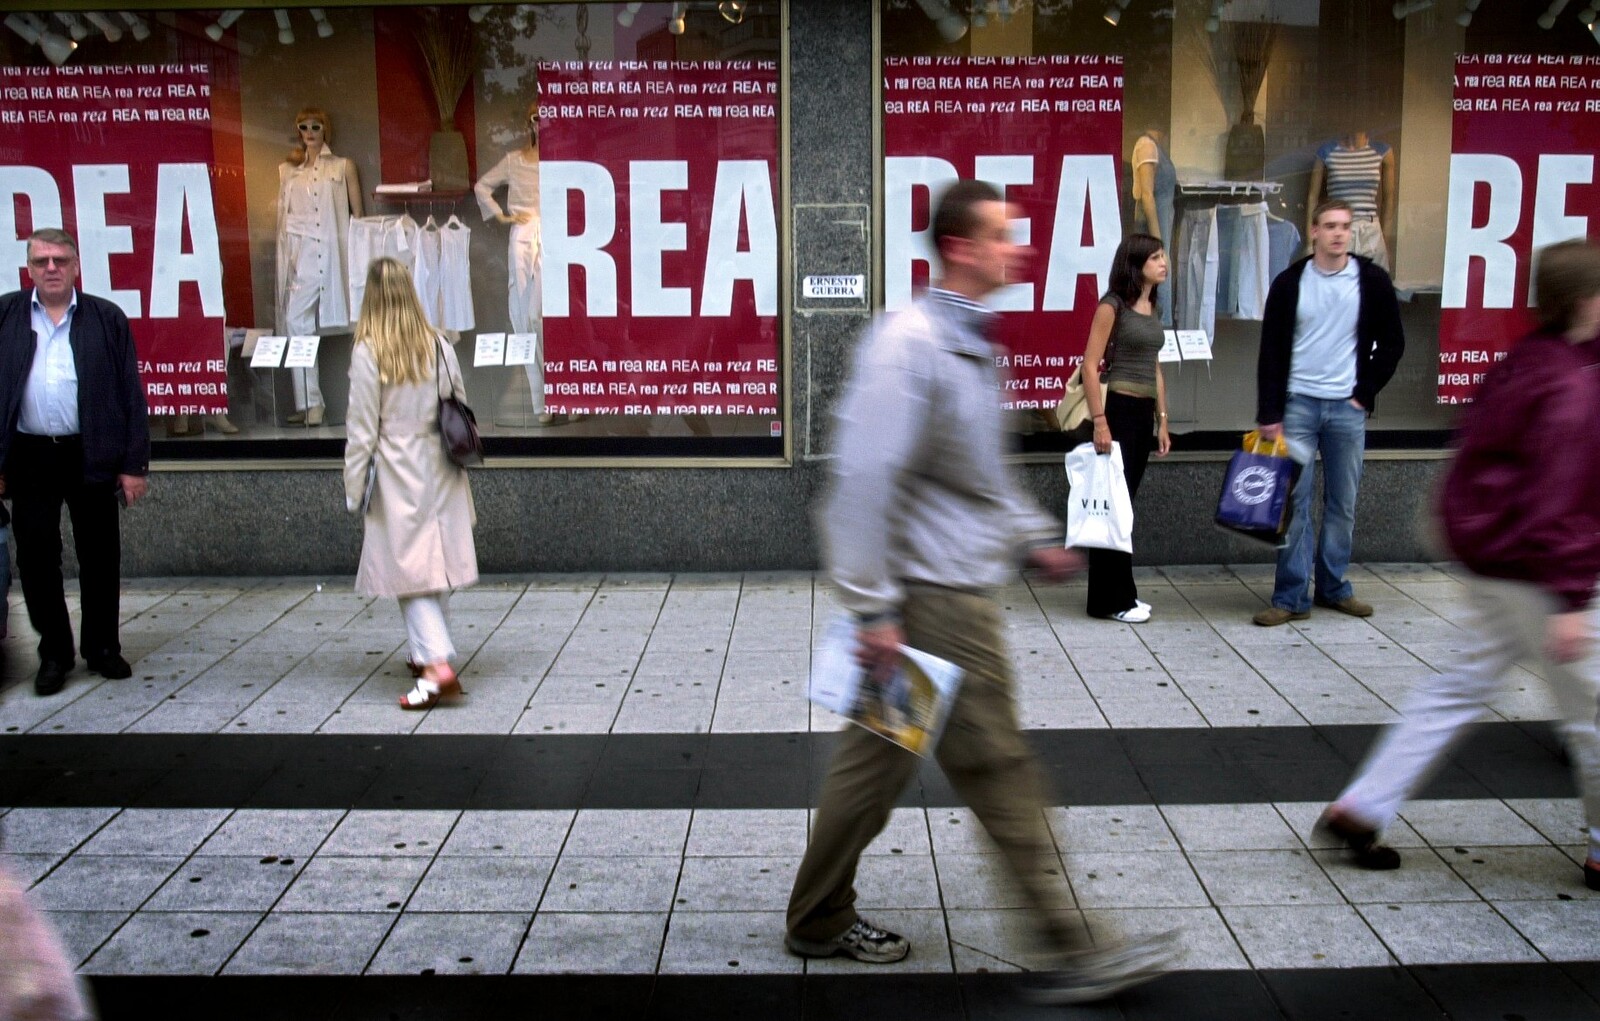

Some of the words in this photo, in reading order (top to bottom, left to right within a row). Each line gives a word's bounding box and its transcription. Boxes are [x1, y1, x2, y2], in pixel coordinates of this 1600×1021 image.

[565, 81, 589, 95] rea
[592, 81, 615, 94] REA
[619, 81, 642, 94] REA
[646, 81, 675, 94] REA
[679, 83, 698, 94] rea
[702, 82, 727, 94] rea
[733, 81, 762, 94] REA
[912, 76, 936, 90] rea
[939, 76, 962, 90] REA
[966, 76, 989, 90] REA
[993, 76, 1022, 90] REA
[1026, 78, 1045, 89] rea
[1049, 76, 1075, 89] rea
[1080, 75, 1109, 89] REA
[1482, 75, 1506, 88] rea
[1508, 76, 1531, 88] REA
[1535, 76, 1557, 89] REA
[1560, 76, 1588, 89] REA
[4, 87, 29, 101] rea
[31, 86, 54, 100] REA
[57, 86, 79, 100] REA
[83, 85, 111, 99] REA
[114, 87, 134, 99] rea
[138, 86, 162, 99] rea
[168, 84, 197, 98] REA
[538, 105, 558, 119] ea
[561, 105, 584, 118] REA
[587, 105, 616, 118] REA
[620, 107, 639, 118] rea
[643, 106, 669, 118] rea
[674, 105, 704, 118] REA
[725, 105, 750, 118] rea
[752, 105, 775, 118] REA
[885, 101, 905, 114] ea
[907, 100, 930, 114] REA
[934, 100, 963, 114] REA
[967, 102, 986, 114] rea
[990, 100, 1016, 113] rea
[1021, 99, 1051, 113] REA
[1072, 99, 1097, 113] rea
[1099, 99, 1122, 113] REA
[1475, 99, 1498, 112] REA
[1502, 99, 1531, 112] REA
[1534, 101, 1553, 112] rea
[1557, 101, 1581, 113] rea
[1, 110, 25, 124] REA
[28, 110, 56, 124] REA
[59, 112, 78, 123] rea
[82, 110, 108, 123] rea
[112, 108, 141, 123] REA
[162, 108, 186, 122] rea
[188, 107, 211, 121] REA
[0, 163, 225, 318] REA
[539, 160, 778, 317] REA
[885, 155, 1122, 312] REA
[810, 277, 858, 286] ERNESTO
[812, 287, 855, 296] GUERRA
[994, 355, 1010, 368] EA
[1014, 354, 1042, 367] REA
[1046, 356, 1064, 367] rea
[1461, 350, 1489, 363] REA
[137, 361, 153, 374] EA
[156, 363, 175, 374] rea
[178, 361, 202, 373] rea
[569, 360, 598, 373] REA
[620, 360, 643, 373] rea
[646, 360, 668, 373] REA
[672, 360, 700, 373] REA
[704, 362, 723, 373] rea
[727, 361, 752, 373] rea
[757, 359, 778, 373] RE
[1005, 378, 1030, 391] rea
[1035, 376, 1063, 390] REA
[1447, 373, 1470, 386] rea
[147, 382, 175, 396] REA
[194, 382, 218, 396] rea
[556, 383, 580, 396] rea
[583, 383, 605, 395] REA
[609, 383, 637, 395] REA
[640, 385, 659, 395] rea
[663, 383, 689, 395] rea
[693, 382, 722, 395] REA
[743, 382, 767, 395] rea
